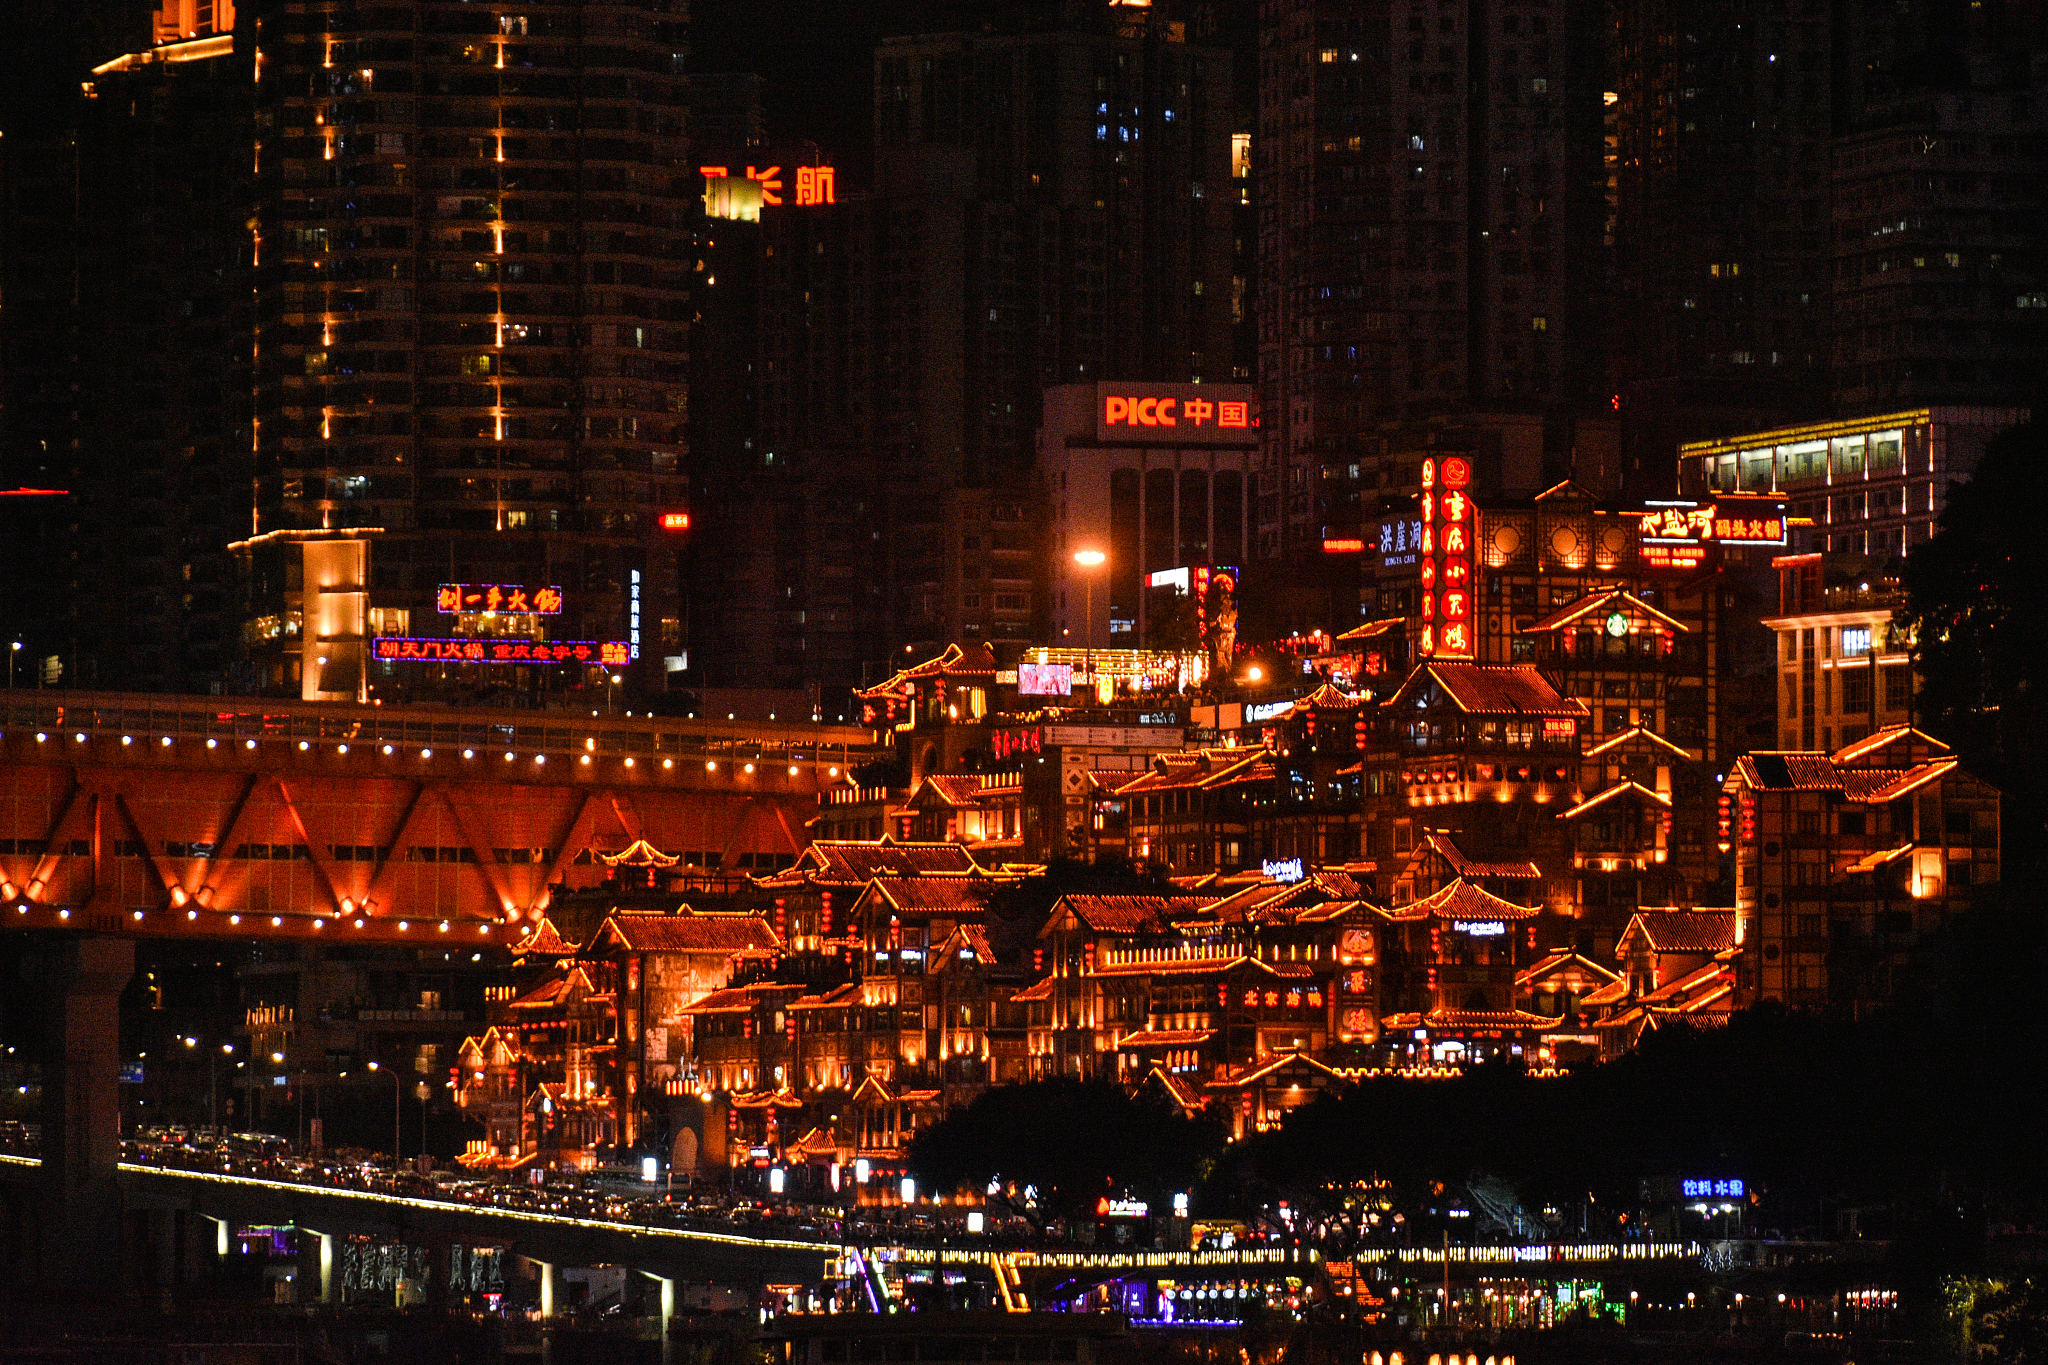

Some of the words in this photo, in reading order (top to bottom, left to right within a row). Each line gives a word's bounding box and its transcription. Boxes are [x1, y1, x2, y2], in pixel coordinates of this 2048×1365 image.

[1106, 396, 1176, 426] PICC
[1381, 520, 1422, 553] 洪崖洞
[1715, 519, 1782, 539] 码头火锅
[378, 641, 485, 659] 朝天门火锅
[492, 643, 593, 660] 重庆老字号
[1243, 989, 1323, 1008] 北京烤鸭
[1682, 1178, 1713, 1198] 饮料
[1714, 1178, 1745, 1198] 水果
